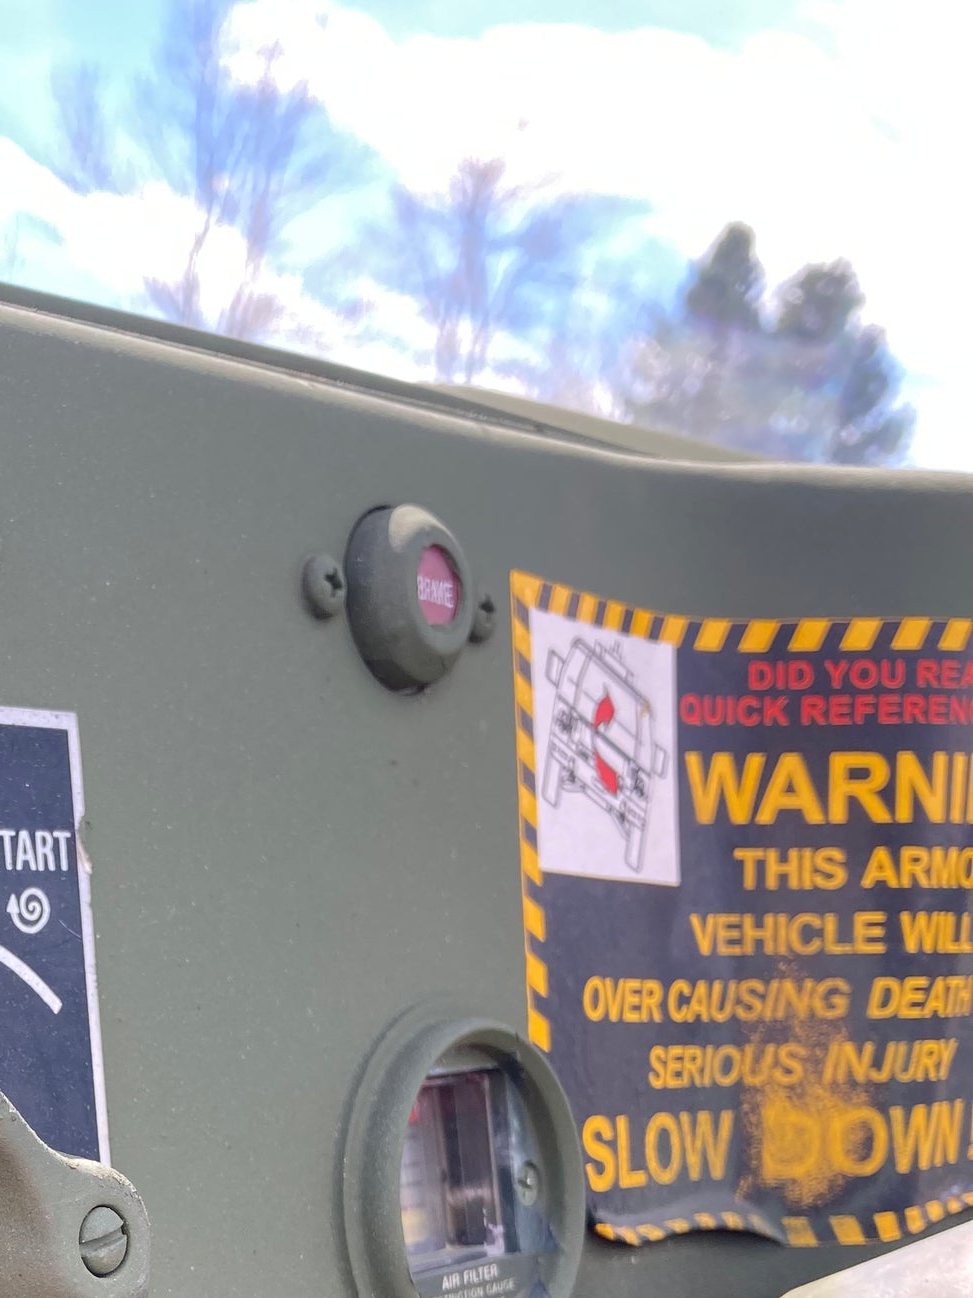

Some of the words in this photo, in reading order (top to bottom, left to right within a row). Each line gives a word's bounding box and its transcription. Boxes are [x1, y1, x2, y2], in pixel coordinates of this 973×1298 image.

[747, 660, 815, 691] DID
[824, 658, 907, 690] YOU
[679, 694, 790, 727] QUICK
[800, 693, 973, 727] REFEREN
[684, 750, 973, 826] WARNI
[733, 846, 849, 891] THIS
[689, 911, 888, 957] VEHICLE
[899, 910, 973, 955] WILL
[582, 975, 664, 1023] OVER
[668, 976, 853, 1024] CAUSING
[865, 974, 973, 1021] DEATH
[648, 1043, 807, 1091] SERIOUS
[823, 1037, 959, 1085] INJURY
[582, 1109, 735, 1194] SLOW
[441, 1272, 461, 1291] AIR
[463, 1263, 498, 1285] FILTER
[486, 1278, 515, 1294] GAUGE
